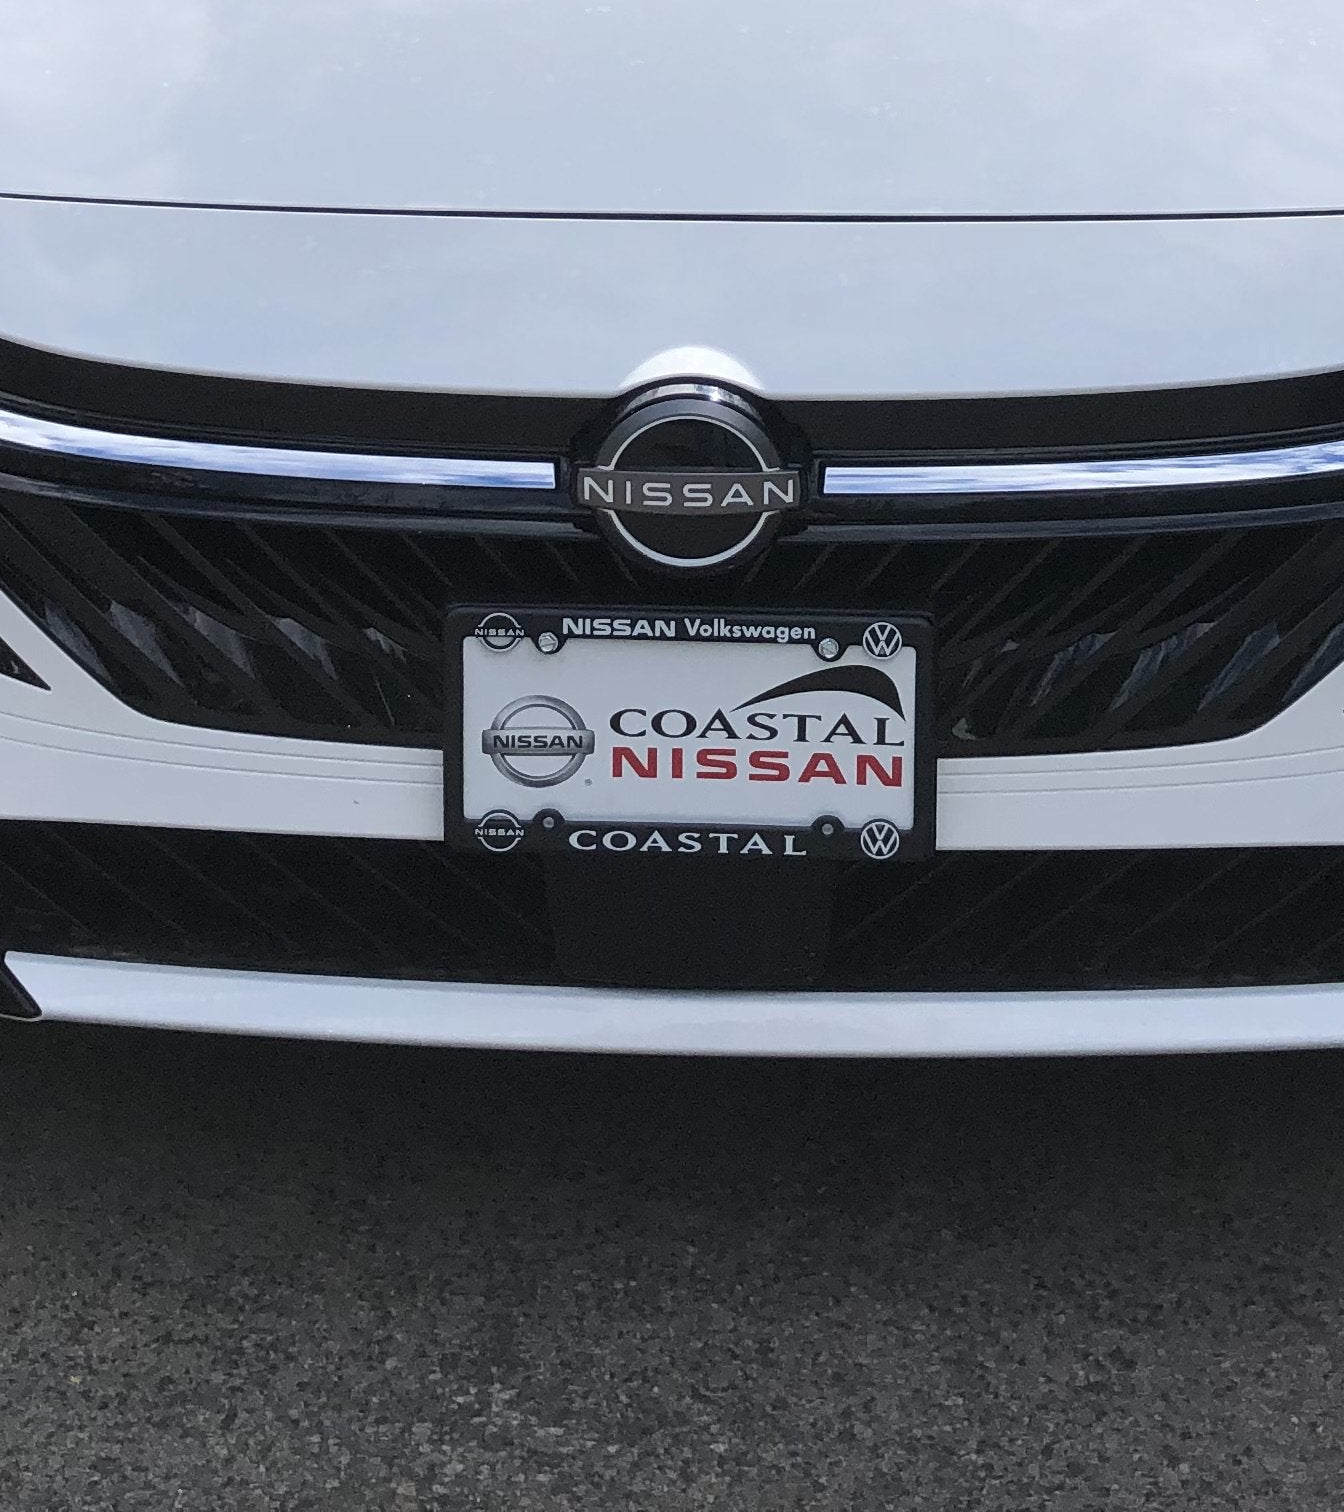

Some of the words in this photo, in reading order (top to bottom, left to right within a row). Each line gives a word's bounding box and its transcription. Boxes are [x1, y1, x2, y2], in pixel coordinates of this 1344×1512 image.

[583, 476, 794, 508] NISSAN
[474, 628, 525, 637] NISSAN
[562, 617, 676, 637] NISSAN
[683, 617, 816, 643] Volkswagen
[609, 707, 905, 747] COASTAL
[493, 734, 583, 749] NISSAN
[612, 746, 903, 787] NISSAN
[474, 828, 525, 837] NISSAN
[568, 829, 807, 856] COASTAL
